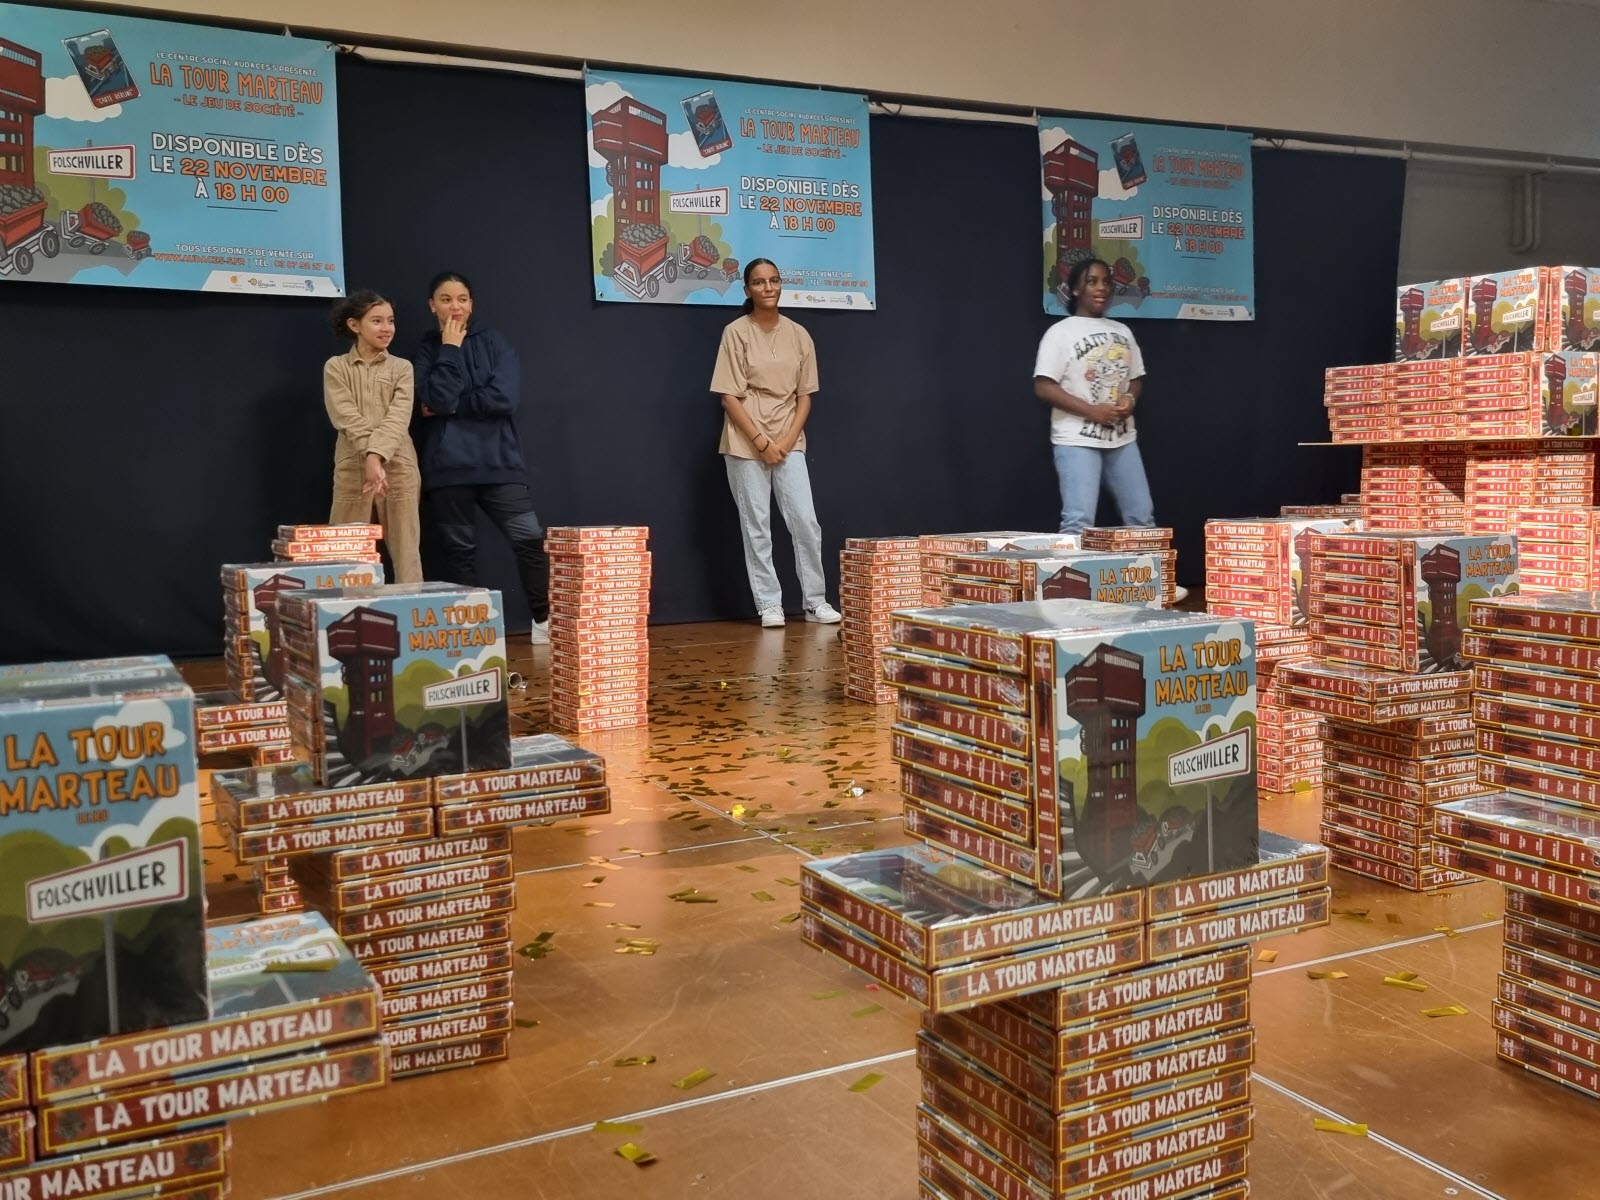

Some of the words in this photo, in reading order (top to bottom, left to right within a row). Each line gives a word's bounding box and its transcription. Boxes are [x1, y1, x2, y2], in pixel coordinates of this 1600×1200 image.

[168, 53, 199, 62] CENTRE
[202, 57, 231, 66] SOCIAL
[278, 65, 318, 76] PRÉSENTE
[150, 62, 172, 87] LA
[180, 66, 229, 94] TOUR
[238, 72, 322, 104] MARTEAU
[183, 94, 197, 105] LE
[201, 96, 222, 108] JEU
[226, 100, 241, 111] DE
[244, 102, 295, 117] SOCIÉTÉ
[752, 109, 775, 117] CENTRE
[740, 118, 755, 138] LA
[761, 119, 794, 141] TOUR
[800, 124, 860, 148] MARTEAU
[152, 132, 278, 161] DISPONIBLE
[284, 142, 323, 164] DÈS
[763, 144, 772, 153] LE
[775, 144, 790, 155] JEU
[792, 146, 802, 155] DE
[805, 147, 841, 159] SOCIÉTÉ
[53, 154, 124, 170] FOLSCHVILLER
[150, 155, 174, 173] LE
[180, 157, 209, 177] 22
[214, 160, 327, 186] NOVEMBRE
[194, 178, 208, 199] À
[215, 183, 235, 200] 18
[242, 185, 256, 202] H
[262, 186, 289, 204] 00
[741, 176, 828, 196] DISPONIBLE
[832, 180, 859, 198] DÈS
[672, 196, 721, 208] FOLSCHVILLER
[739, 194, 756, 209] LE
[760, 196, 780, 211] 22
[783, 198, 862, 216] NOVEMBRE
[1153, 206, 1218, 222] DISPONIBLE
[1221, 208, 1242, 224] DÈS
[769, 212, 780, 229] À
[783, 215, 798, 230] 18
[802, 217, 813, 231] H
[816, 218, 835, 232] 00
[1101, 222, 1137, 234] FOLSCHVILLER
[1151, 222, 1164, 234] LE
[1167, 222, 1183, 235] 22
[1186, 224, 1245, 239] NOVEMBRE
[176, 244, 200, 252] TOUS
[221, 247, 252, 256] POINTS
[269, 250, 295, 259] VENTE
[297, 252, 314, 260] SUR
[1174, 236, 1182, 250] À
[1185, 239, 1196, 251] 18
[1199, 242, 1207, 253] H
[1208, 242, 1223, 253] 00
[1215, 526, 1222, 534] LA
[1223, 526, 1236, 534] TOUR
[1238, 526, 1264, 534] MARTEAU
[1467, 546, 1482, 560] LA
[1485, 544, 1510, 559] TOUR
[1100, 568, 1117, 585] LA
[1121, 566, 1152, 584] TOUR
[1466, 562, 1514, 577] MARTEAU
[1097, 586, 1156, 603] MARTEAU
[412, 607, 438, 628] LA
[443, 603, 489, 625] TOUR
[408, 626, 496, 651] MARTEAU
[1160, 644, 1187, 673] LA
[1192, 638, 1242, 669] TOUR
[428, 679, 490, 702] FOLSCHVILLER
[1155, 671, 1248, 706] MARTEAU
[1388, 684, 1398, 695] LA
[1401, 681, 1420, 693] TOUR
[1422, 678, 1458, 690] MARTEAU
[1386, 706, 1397, 716] LA
[1400, 702, 1419, 715] TOUR
[1421, 697, 1456, 711] MARTEAU
[4, 732, 58, 772] LA
[68, 721, 166, 764] TOUR
[1173, 744, 1239, 777] FOLSCHVILLER
[0, 764, 180, 816] MARTEAU
[460, 779, 480, 796] LA
[483, 774, 518, 792] TOUR
[519, 768, 582, 789] MARTEAU
[268, 803, 289, 820] LA
[292, 796, 331, 818] TOUR
[334, 789, 404, 812] MARTEAU
[466, 810, 486, 825] LA
[488, 804, 523, 823] TOUR
[526, 798, 586, 819] MARTEAU
[267, 835, 288, 852] LA
[291, 829, 330, 850] TOUR
[332, 821, 404, 844] MARTEAU
[362, 855, 382, 871] LA
[384, 847, 420, 867] TOUR
[423, 837, 488, 861] MARTEAU
[37, 861, 166, 910] FOLSCHVILLER
[1175, 886, 1195, 907] LA
[1199, 879, 1236, 903] TOUR
[1239, 864, 1305, 894] MARTEAU
[363, 914, 383, 930] LA
[386, 907, 423, 926] TOUR
[426, 896, 491, 921] MARTEAU
[1175, 928, 1196, 948] LA
[1200, 918, 1237, 944] TOUR
[1239, 903, 1306, 934] MARTEAU
[963, 929, 986, 952] LA
[990, 920, 1034, 945] TOUR
[1037, 903, 1115, 939] MARTEAU
[967, 973, 990, 997] LA
[994, 962, 1036, 988] TOUR
[1040, 943, 1117, 980] MARTEAU
[1088, 992, 1107, 1012] LA
[1112, 982, 1150, 1007] TOUR
[1156, 964, 1225, 997] MARTEAU
[88, 1052, 125, 1080] LA
[137, 1034, 203, 1071] TOUR
[211, 1010, 332, 1050] MARTEAU
[1087, 1075, 1106, 1095] LA
[1111, 1065, 1150, 1090] TOUR
[1156, 1047, 1226, 1081] MARTEAU
[94, 1102, 132, 1132] LA
[140, 1086, 209, 1122] TOUR
[217, 1064, 340, 1109] MARTEAU
[41, 1152, 175, 1198] MARTEAU
